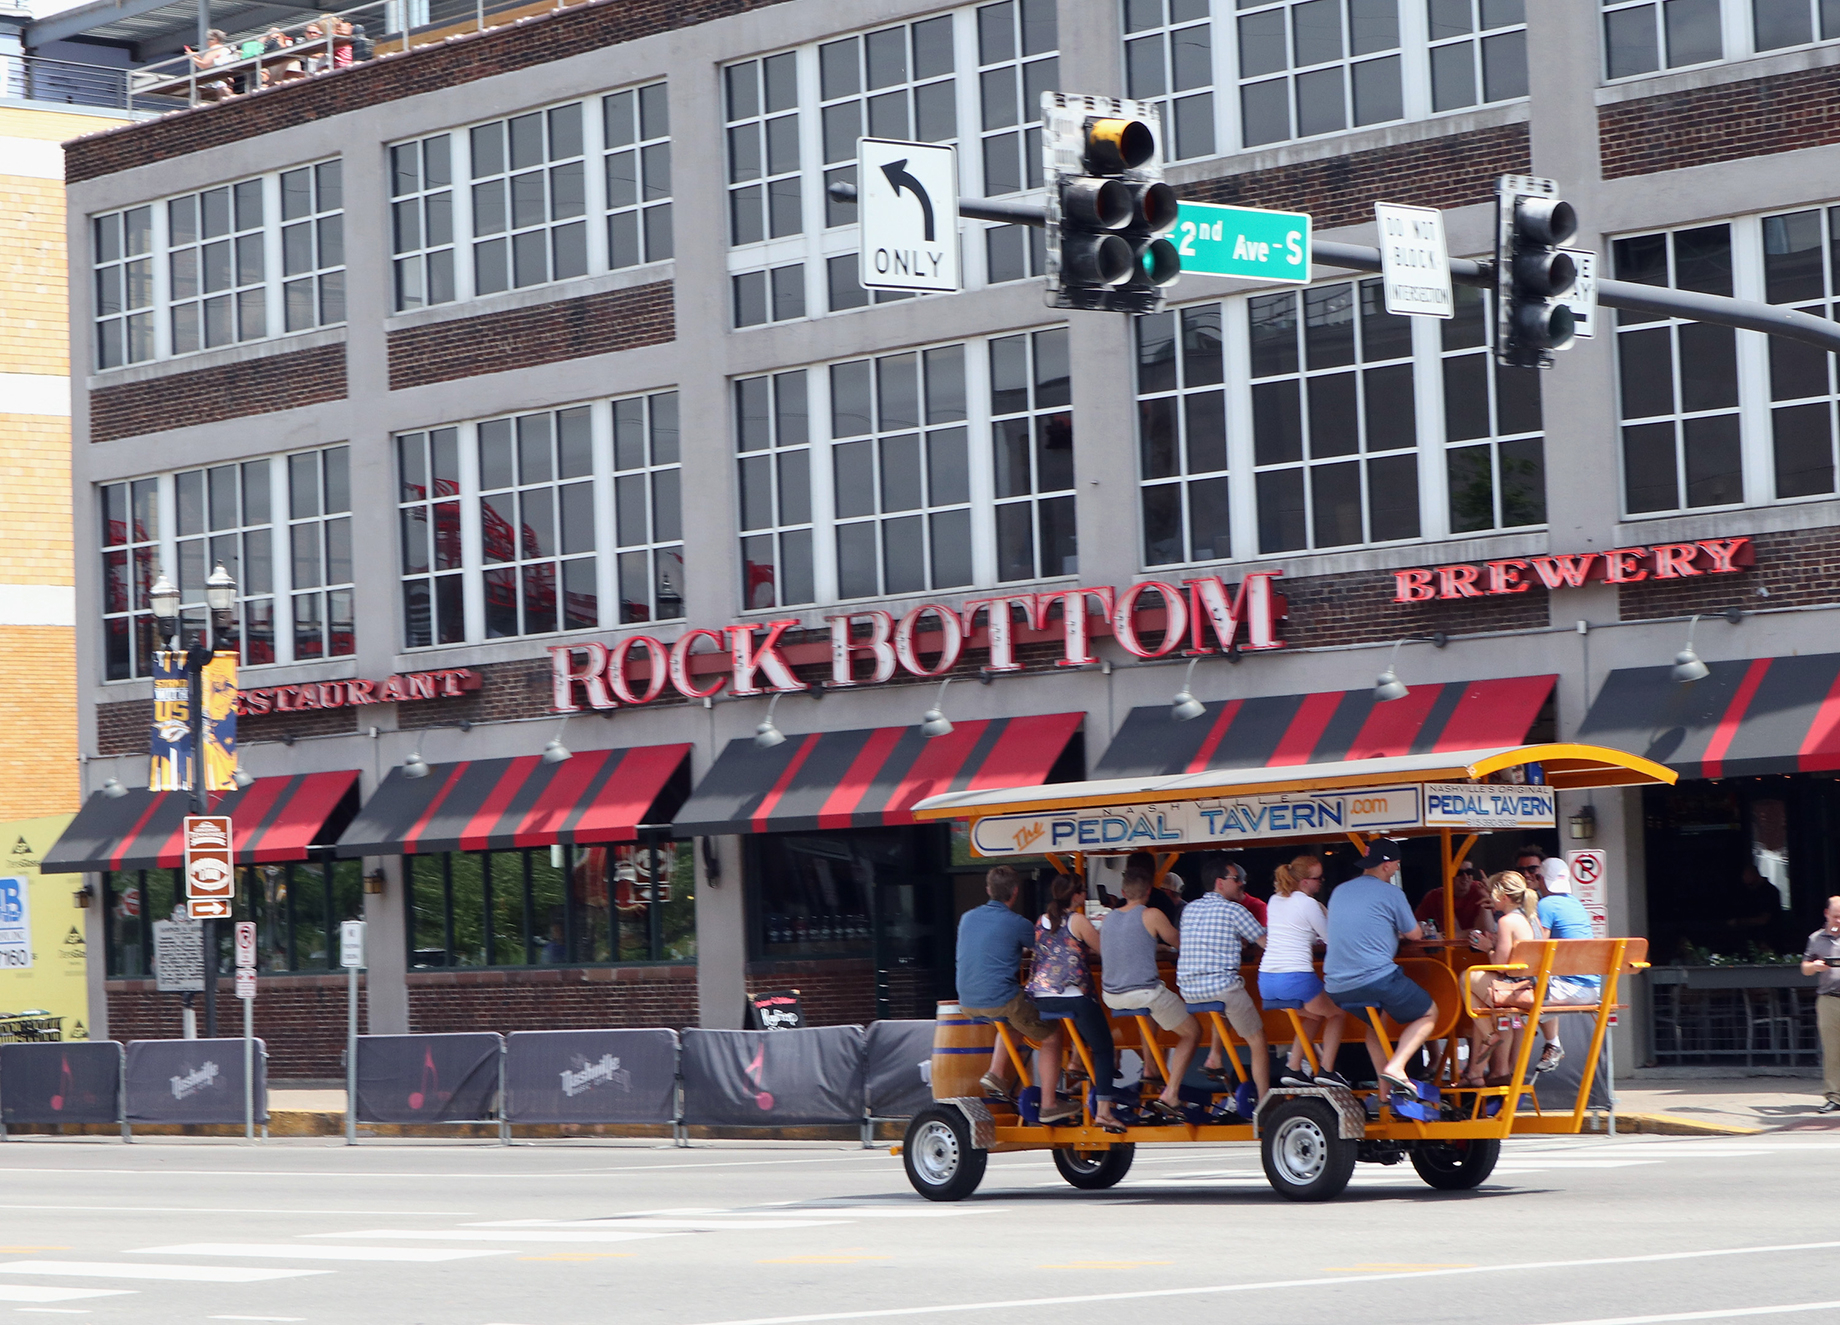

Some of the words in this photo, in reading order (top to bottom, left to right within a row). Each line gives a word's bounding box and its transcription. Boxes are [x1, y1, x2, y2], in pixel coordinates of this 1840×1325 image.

[1386, 217, 1403, 237] DO
[1411, 220, 1436, 240] NOT
[874, 247, 944, 278] ONLY
[1394, 246, 1438, 269] BLOCK
[1389, 283, 1450, 304] INTERSECTION
[1393, 536, 1752, 602] BREWERY
[545, 619, 811, 712] ROCK
[821, 569, 1287, 688] BOTTOM
[154, 701, 190, 721] US
[1429, 785, 1495, 793] NASHVILLE'S
[1499, 786, 1549, 794] ORIGINAL
[1428, 795, 1489, 815] PEDAL
[1491, 796, 1553, 815] TAVERN
[1012, 820, 1046, 850] The
[1052, 813, 1182, 846] PEDAL
[1200, 801, 1346, 835] TAVERN
